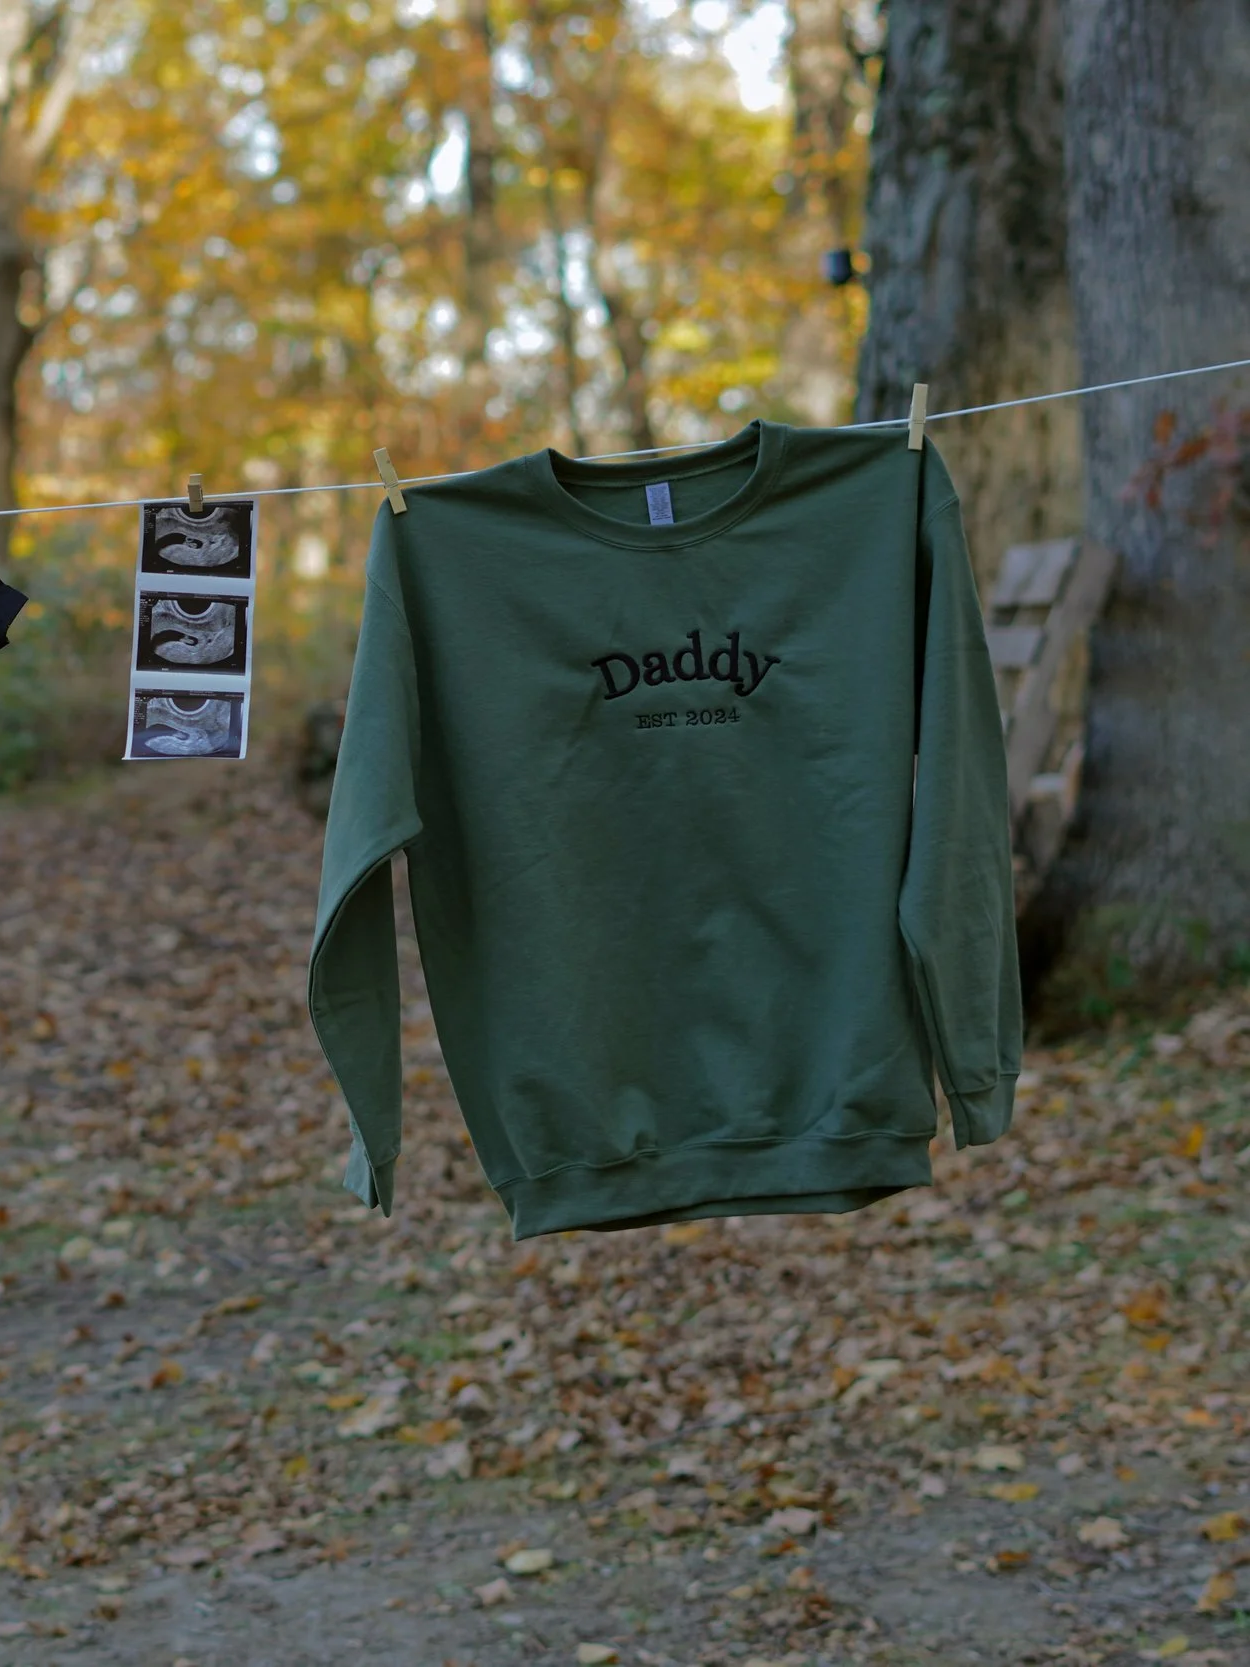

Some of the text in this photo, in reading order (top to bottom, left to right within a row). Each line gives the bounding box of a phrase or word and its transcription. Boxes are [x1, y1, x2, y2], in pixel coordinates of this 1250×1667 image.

[591, 629, 781, 700] Daddy
[635, 707, 741, 729] EST 2024
